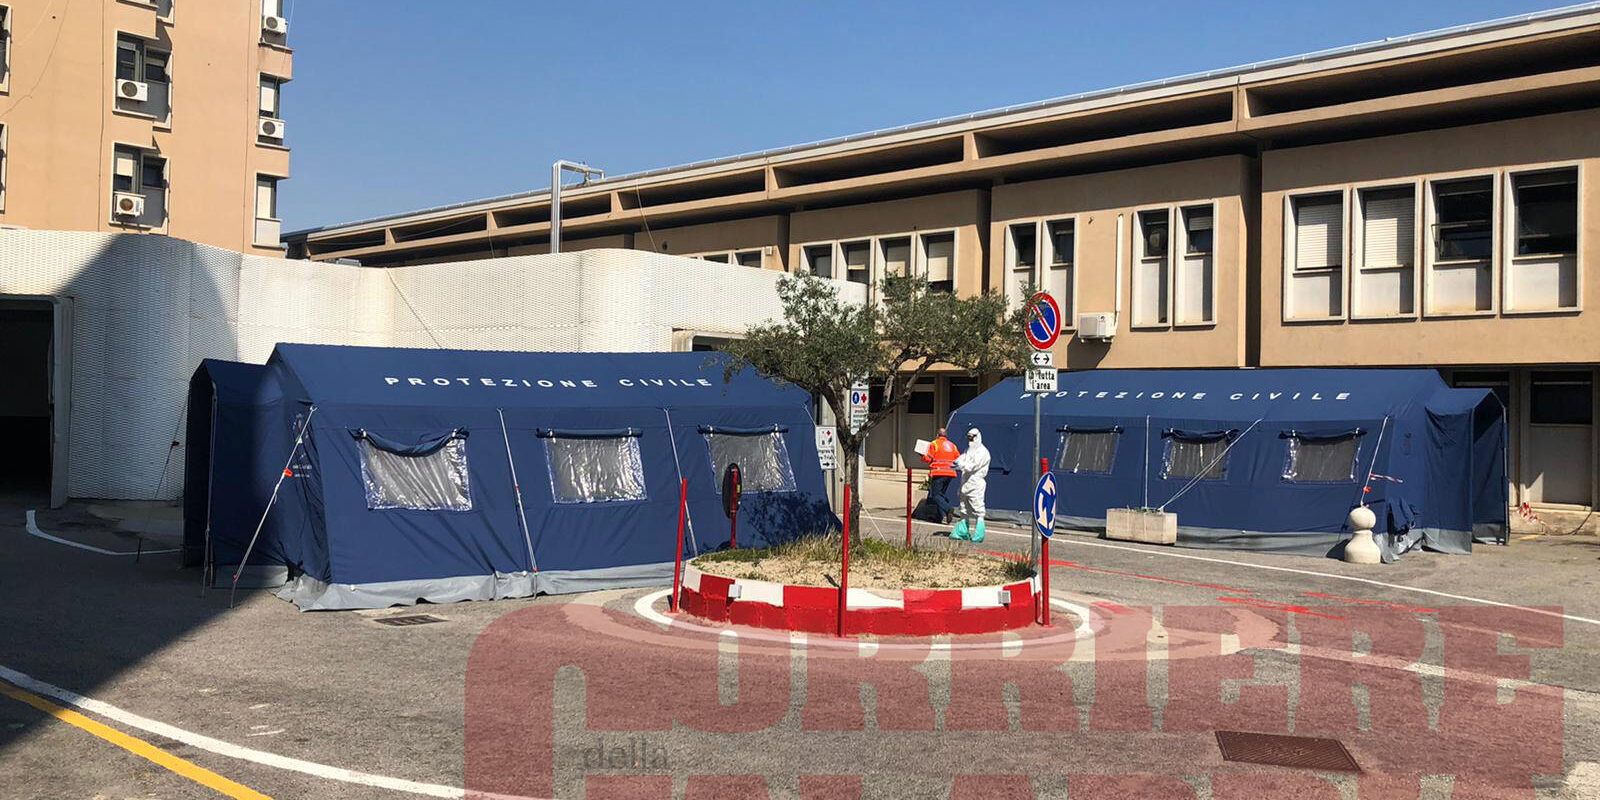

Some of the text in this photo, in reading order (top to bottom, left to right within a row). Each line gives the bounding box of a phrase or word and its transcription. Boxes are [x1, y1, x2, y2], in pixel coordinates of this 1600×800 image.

[384, 377, 712, 388] PROTEZIONE CIVILE
[1032, 380, 1050, 390] l'area
[1020, 391, 1352, 401] PROTEZIONE CIVILE
